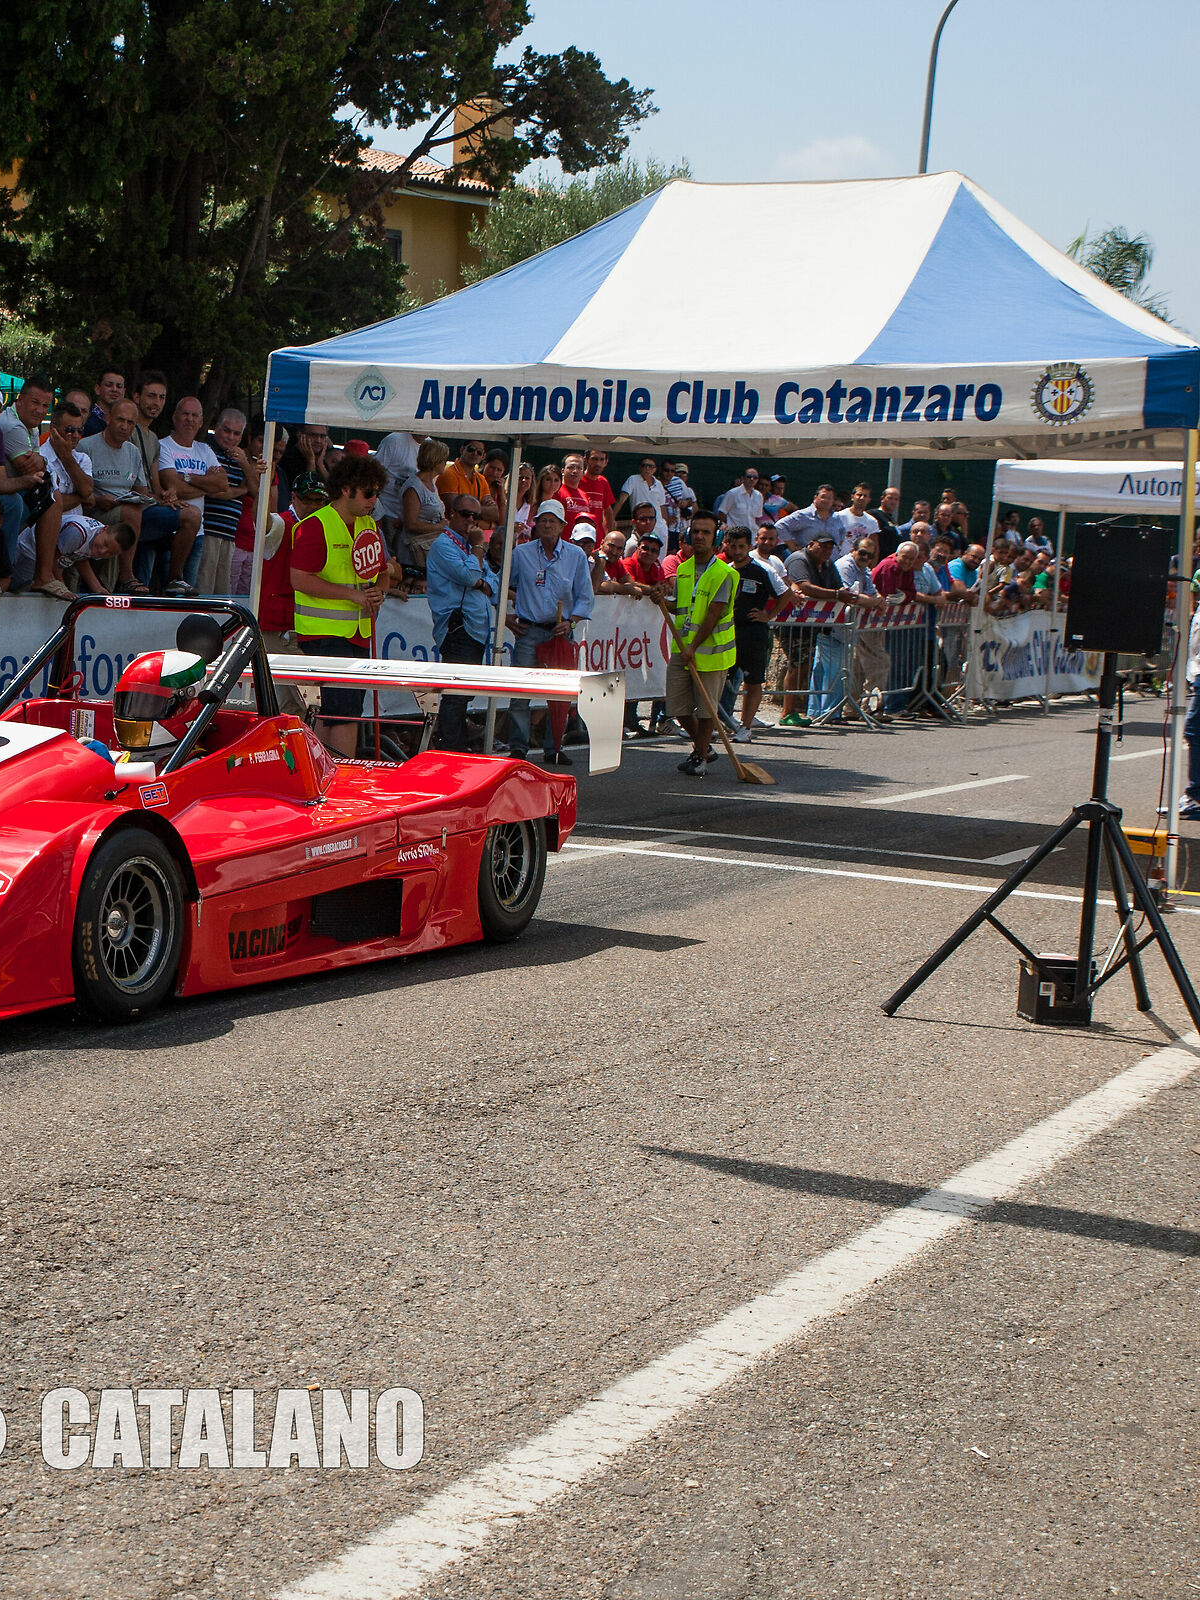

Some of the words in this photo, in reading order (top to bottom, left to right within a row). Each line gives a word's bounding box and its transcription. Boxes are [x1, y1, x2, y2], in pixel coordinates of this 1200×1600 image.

[414, 378, 650, 423] Automobile
[666, 380, 760, 424] Club
[774, 379, 1003, 424] Catanzaro
[353, 541, 382, 571] STOP
[105, 597, 130, 608] SBD
[143, 787, 163, 801] GET
